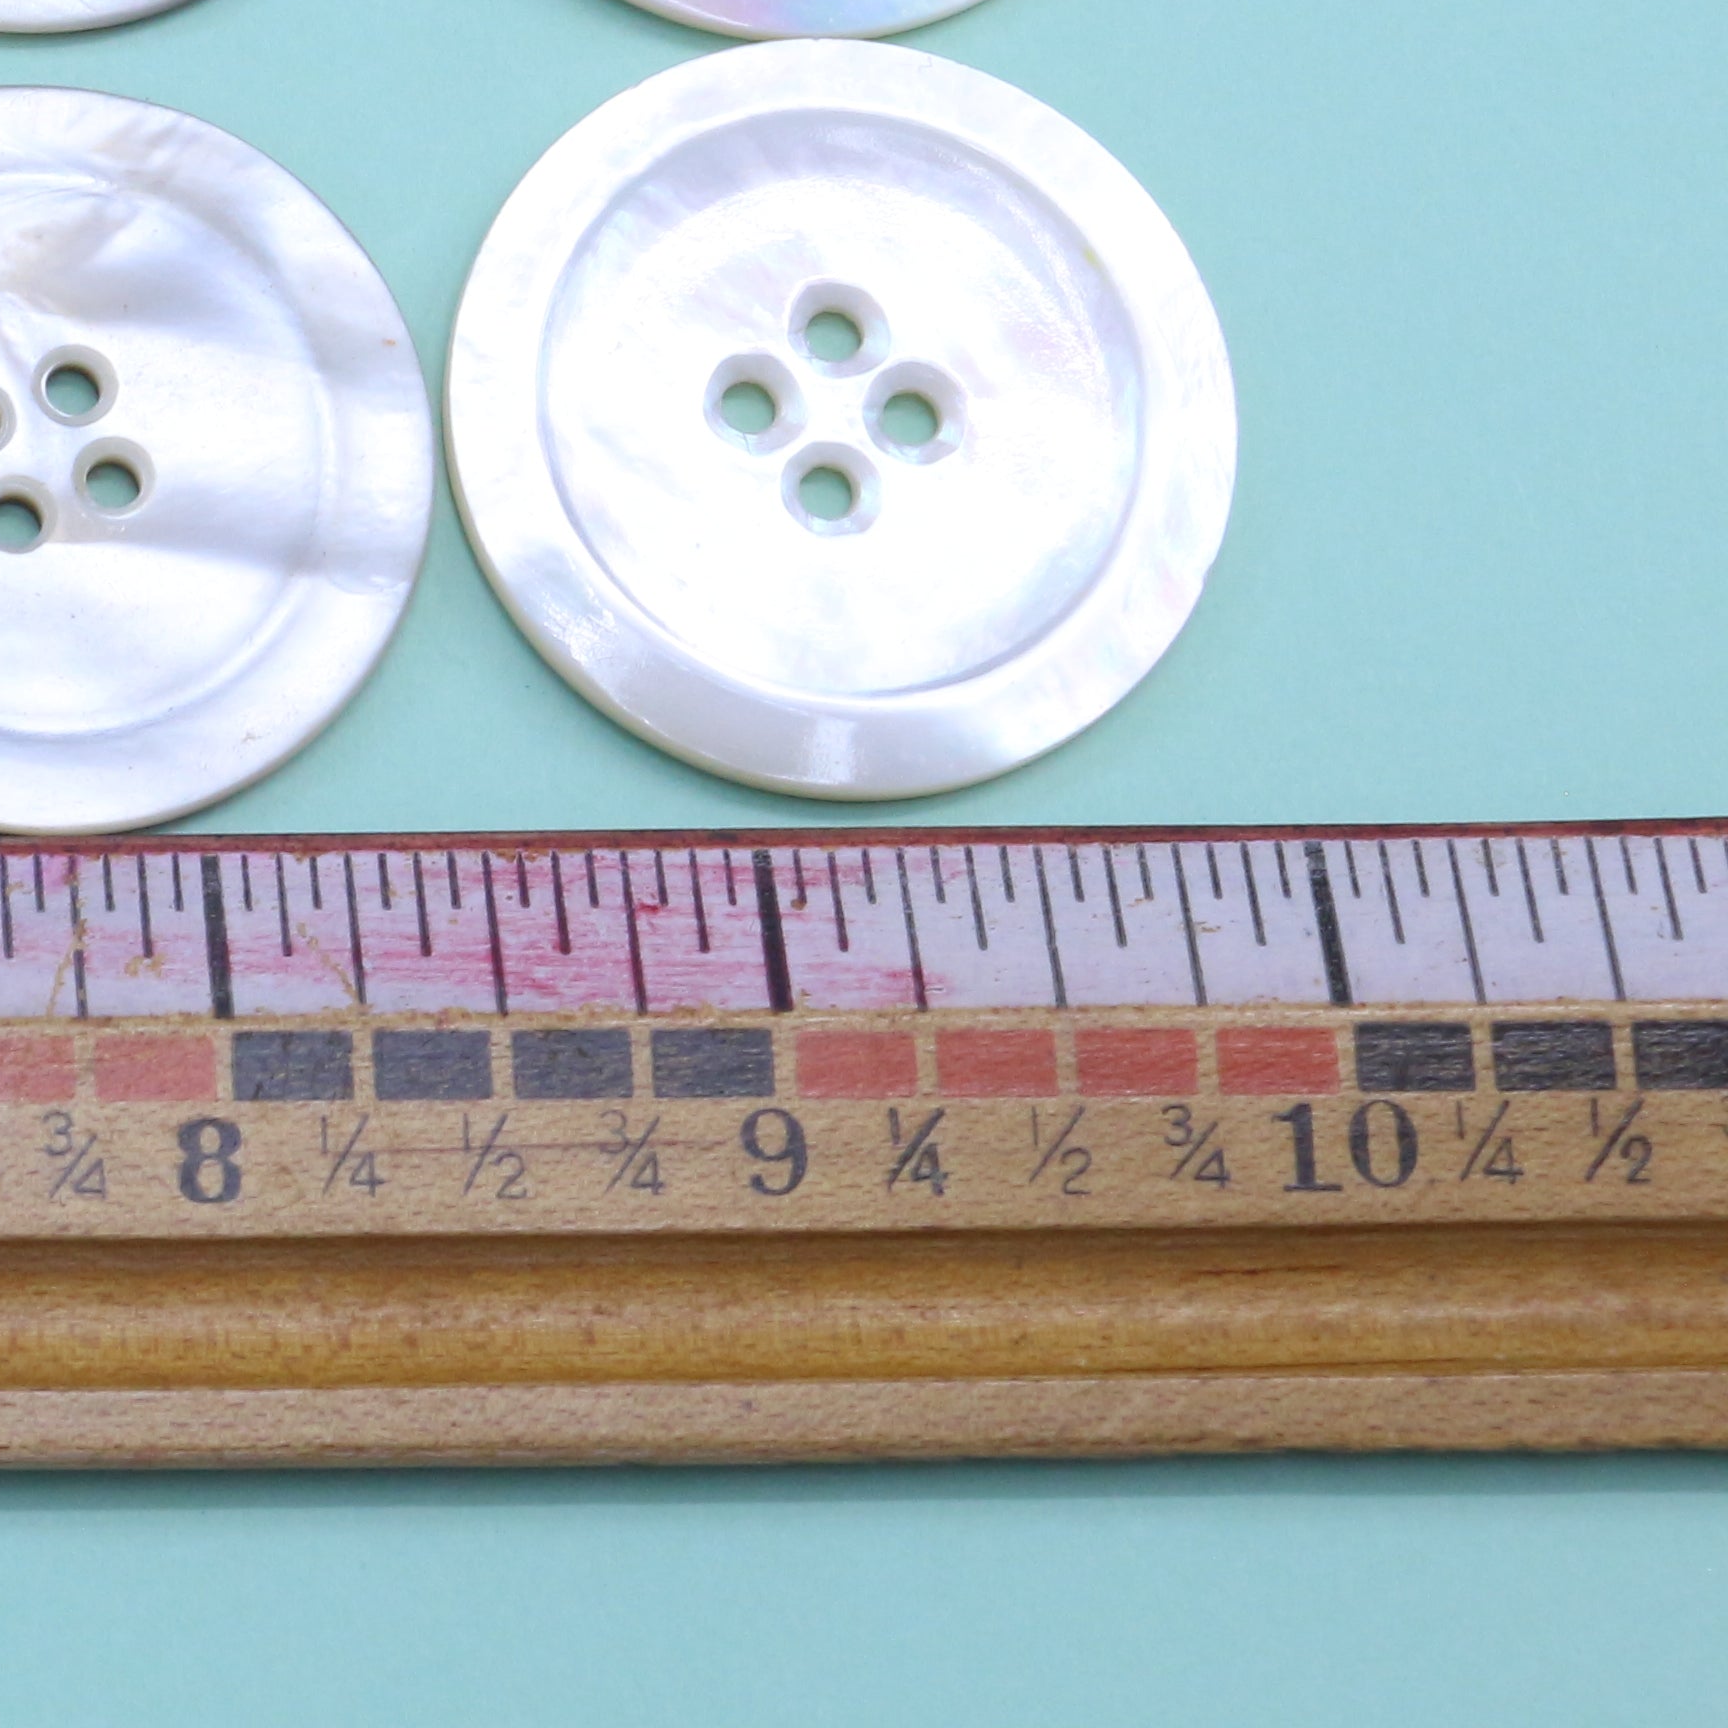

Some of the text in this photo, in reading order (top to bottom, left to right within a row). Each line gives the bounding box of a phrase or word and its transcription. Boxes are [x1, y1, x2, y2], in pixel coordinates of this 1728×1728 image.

[175, 1117, 243, 1205] 8
[739, 1107, 809, 1196] 9
[1271, 1099, 1419, 1193] 10
